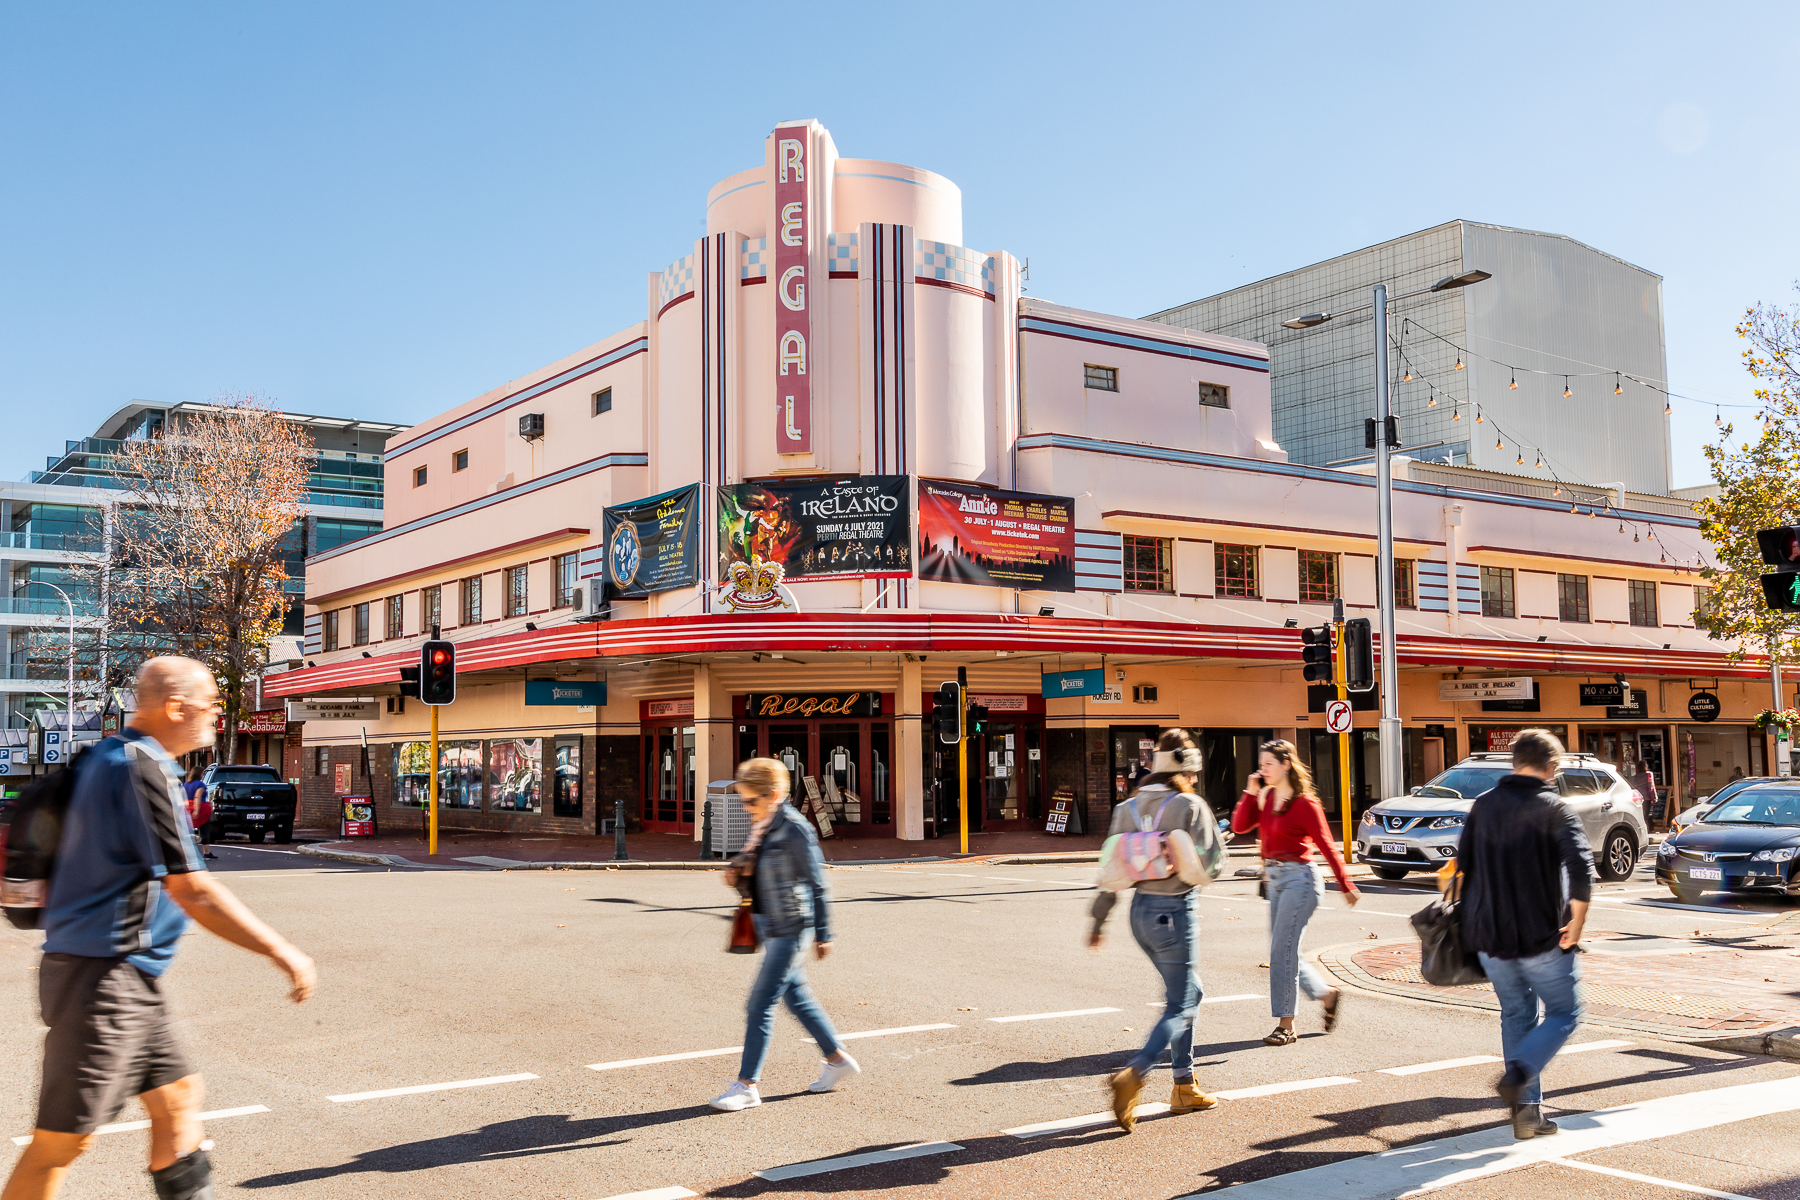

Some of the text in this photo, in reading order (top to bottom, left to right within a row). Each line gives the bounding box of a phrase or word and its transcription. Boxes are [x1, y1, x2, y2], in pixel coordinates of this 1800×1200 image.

[779, 138, 806, 440] REGAL
[820, 486, 880, 498] A TASTE OF
[932, 488, 950, 497] Mercedes
[950, 490, 963, 499] College
[661, 498, 676, 508] The
[800, 494, 898, 519] IRELAND
[958, 495, 998, 516] Annie
[1004, 503, 1024, 512] THOMAS
[656, 507, 686, 520] Addams
[1026, 506, 1047, 515] CHARLES
[1026, 512, 1048, 521] STROUSE
[659, 518, 684, 531] Family
[816, 523, 843, 534] SUNDAY
[850, 522, 866, 532] JULY
[867, 521, 884, 530] 2021
[964, 516, 972, 524] 30
[995, 519, 1017, 529] AUGUST
[1023, 522, 1041, 532] REGAL
[1041, 524, 1065, 534] THEATRE
[817, 529, 884, 541] PERTH REGAL THEATRE
[991, 529, 1040, 540] www.ticketek.com
[1062, 679, 1084, 689] TICKETEK
[553, 689, 582, 698] TICKETEK
[1584, 686, 1597, 695] MO
[1607, 686, 1619, 695] JO
[1113, 691, 1123, 701] RD.
[759, 692, 860, 717] Regal
[49, 734, 58, 743] P
[1490, 731, 1517, 739] ALL STOC
[1, 750, 8, 758] P
[1691, 870, 1720, 880] 1CTS 221
